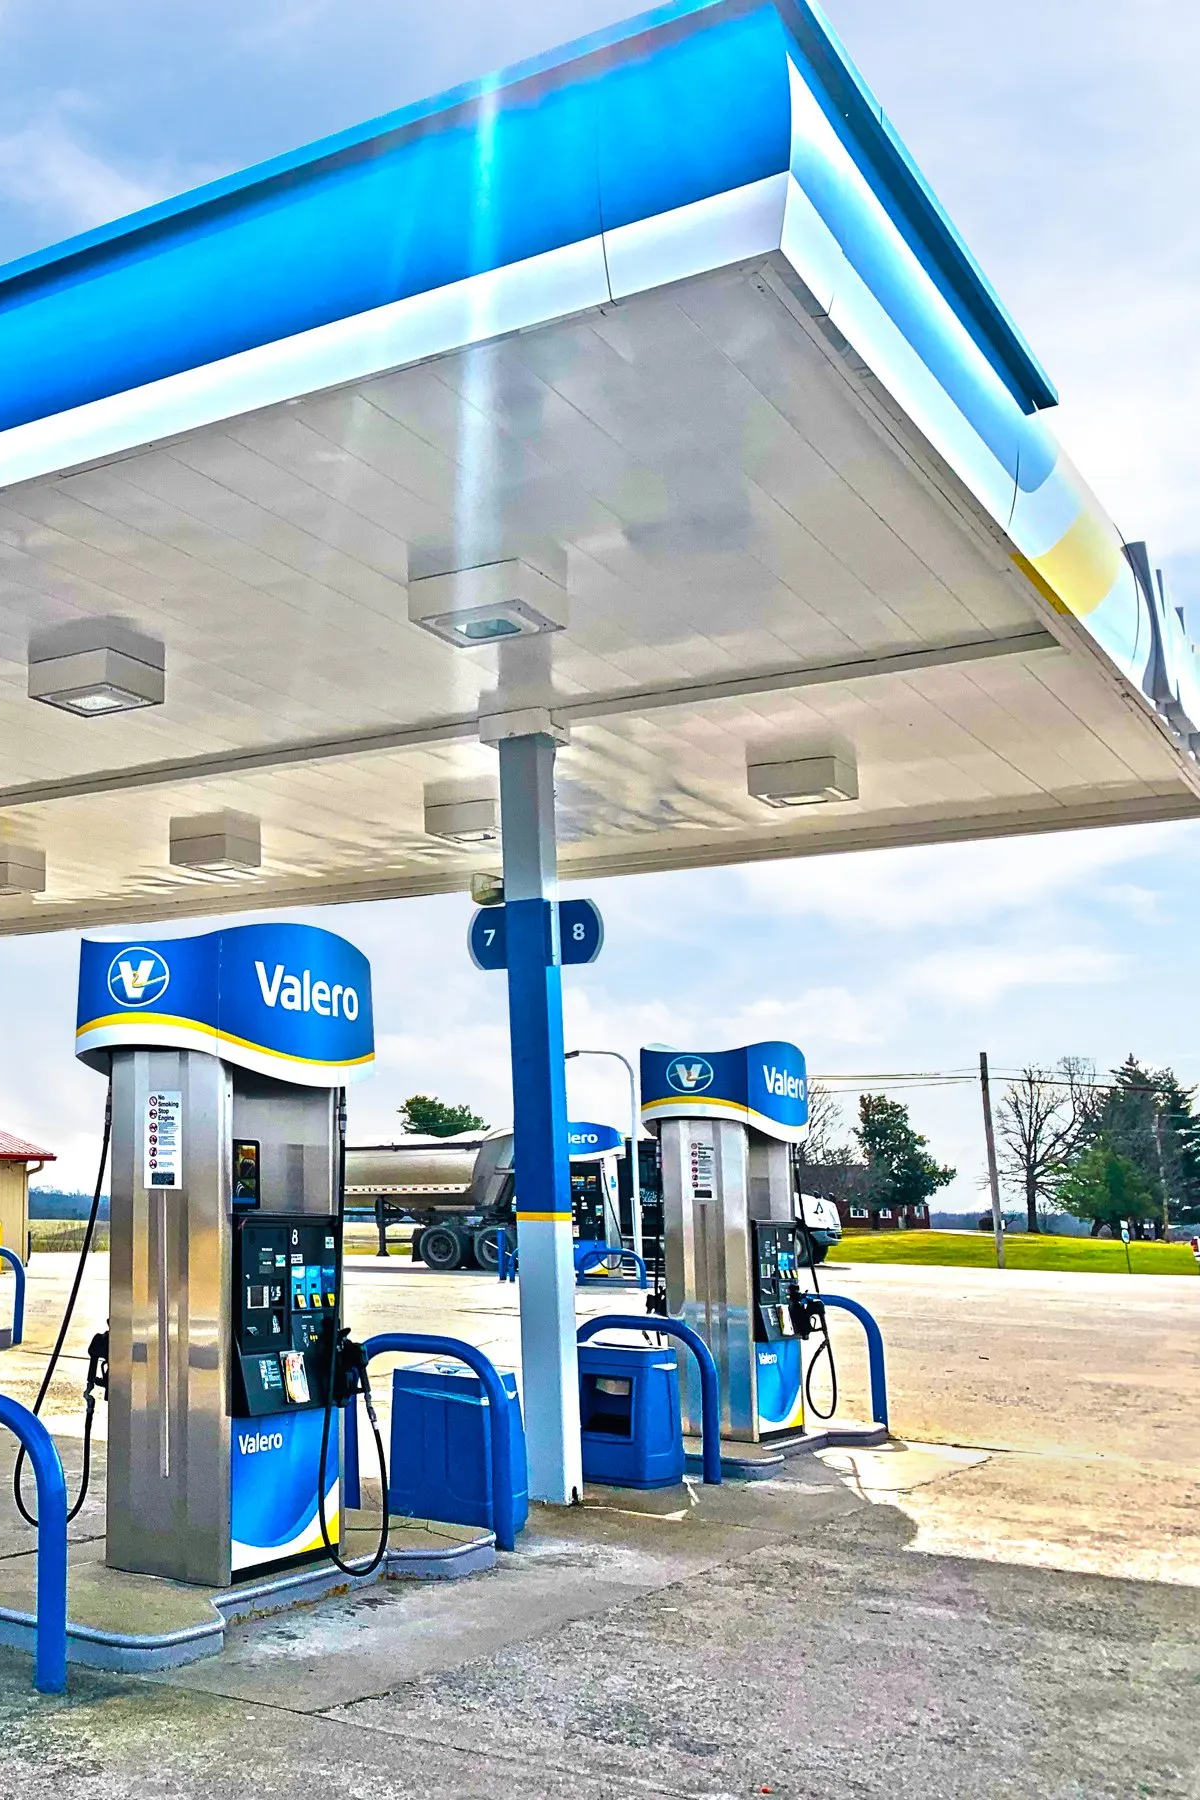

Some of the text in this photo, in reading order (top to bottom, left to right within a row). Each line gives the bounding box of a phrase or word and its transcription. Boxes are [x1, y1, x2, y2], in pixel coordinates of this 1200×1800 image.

[484, 929, 496, 947] 7
[572, 923, 585, 941] 8
[254, 960, 359, 1021] Valero
[762, 1064, 804, 1101] Valero
[568, 1132, 599, 1144] lero
[292, 1228, 298, 1245] 8
[239, 1432, 283, 1455] Valero
